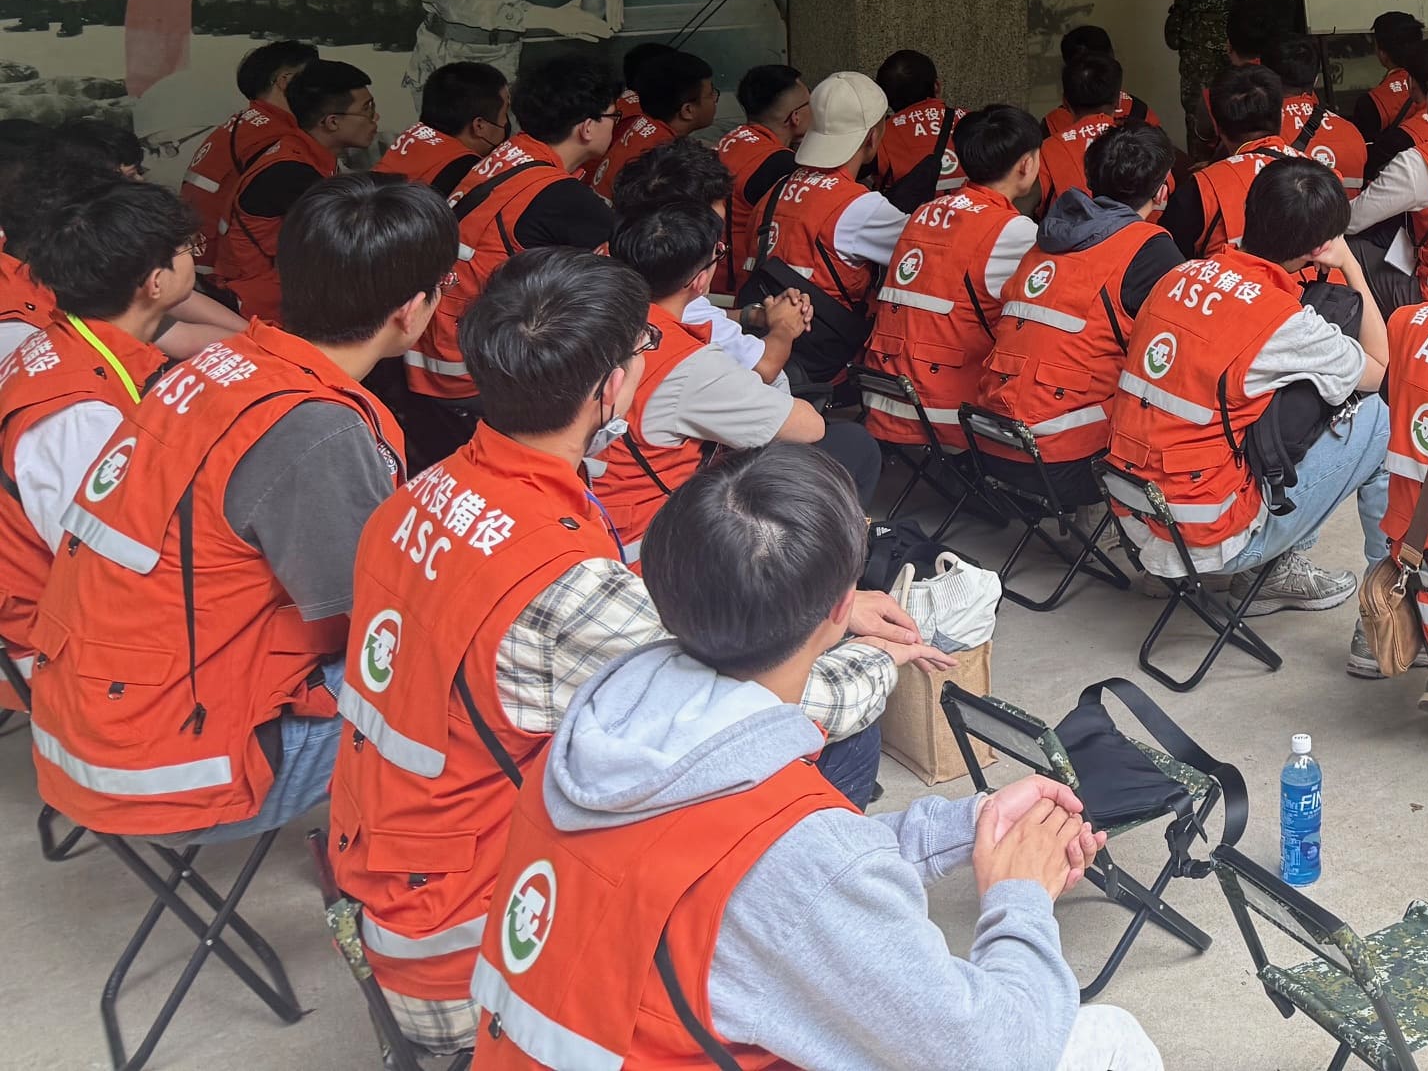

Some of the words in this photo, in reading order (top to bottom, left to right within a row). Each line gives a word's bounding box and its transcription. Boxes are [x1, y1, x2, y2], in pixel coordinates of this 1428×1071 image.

[893, 107, 967, 127] 替代役
[1294, 113, 1334, 130] AC
[390, 134, 416, 155] SC
[779, 183, 810, 203] SC
[915, 206, 956, 229] ASC
[1168, 276, 1223, 315] ASC
[152, 368, 205, 415] ASC
[391, 506, 451, 581] ASC
